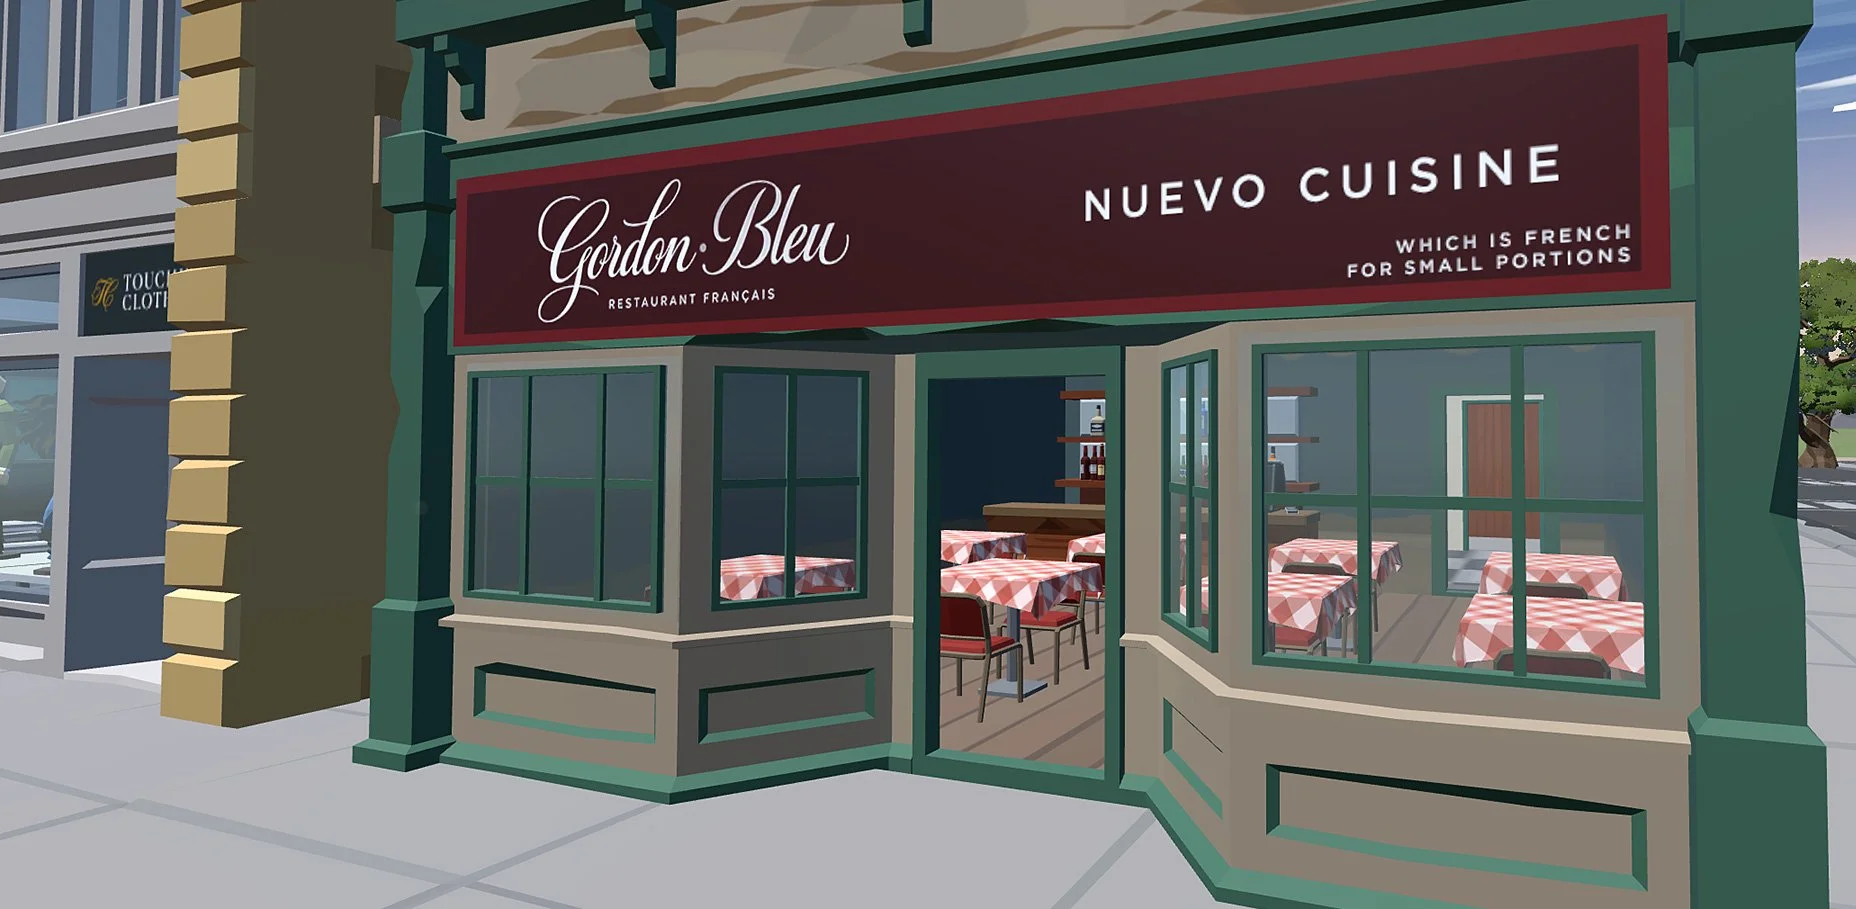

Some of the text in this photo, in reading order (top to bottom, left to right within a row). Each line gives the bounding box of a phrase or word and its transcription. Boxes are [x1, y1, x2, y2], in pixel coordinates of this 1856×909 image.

[1084, 143, 1560, 222] NUEVO CUISINE
[537, 178, 850, 323] Gordon Bleu
[1395, 223, 1631, 254] WHICH IS FRENCH
[1347, 246, 1631, 279] FOR SMALL PORTIONS
[608, 287, 776, 310] RESTAURANT FRANÇAIS
